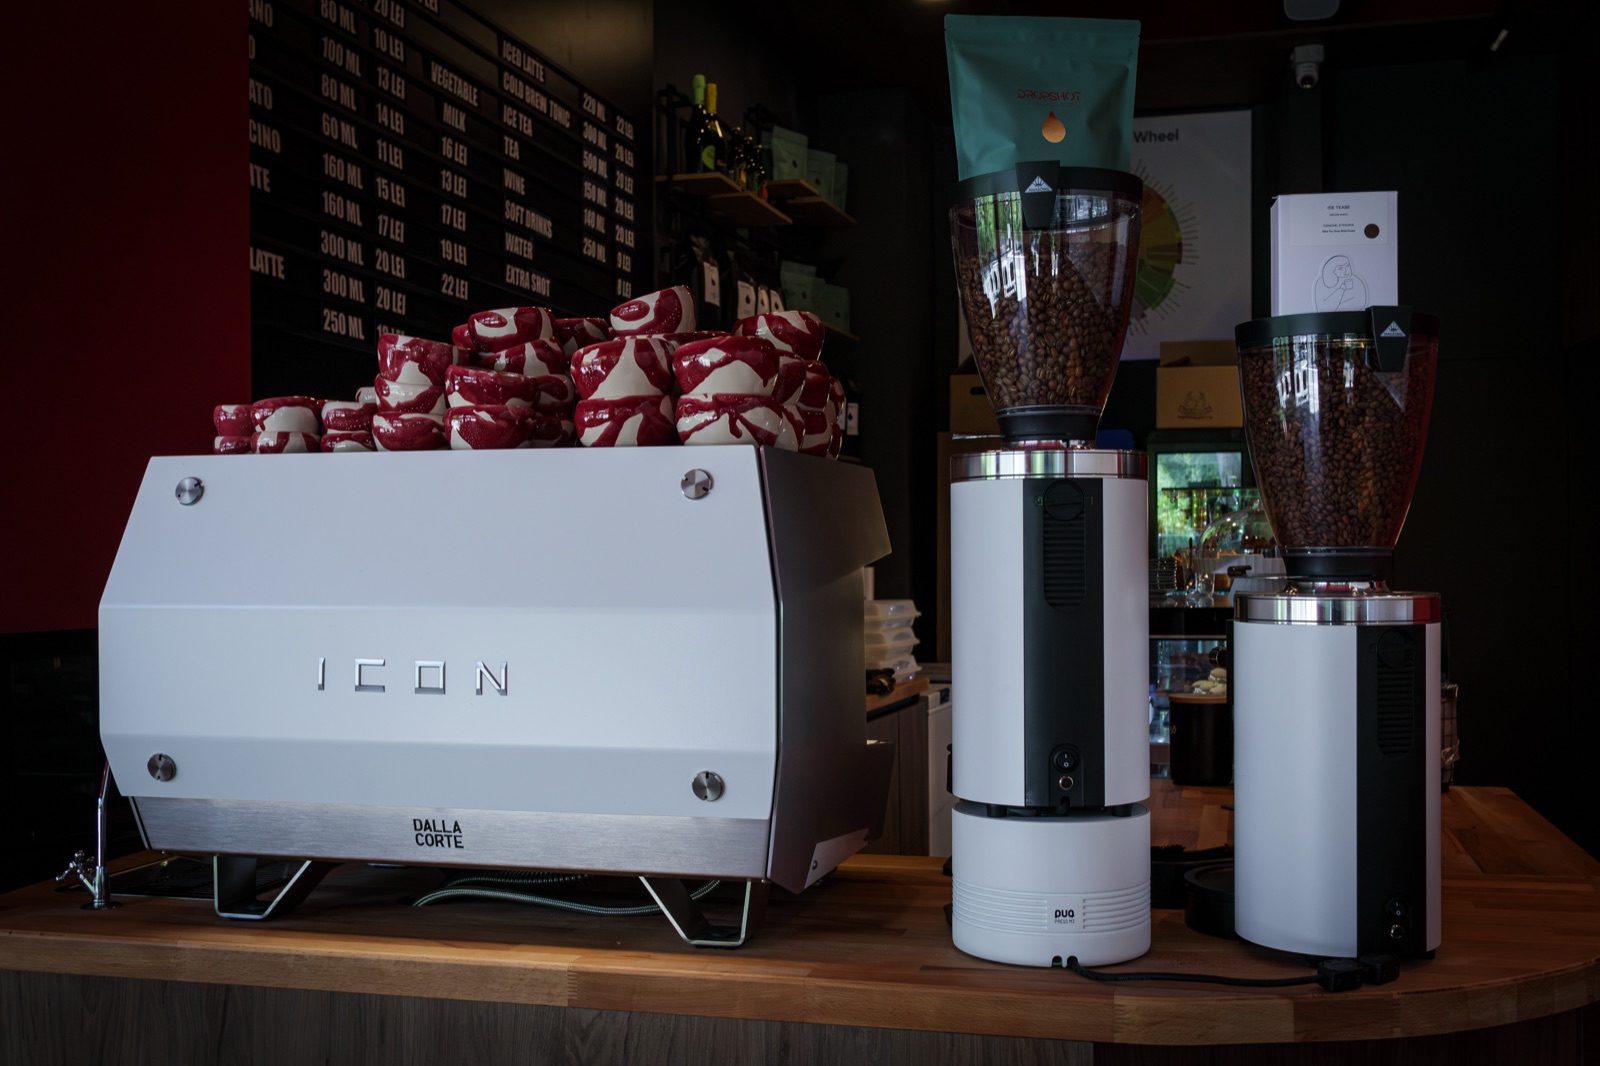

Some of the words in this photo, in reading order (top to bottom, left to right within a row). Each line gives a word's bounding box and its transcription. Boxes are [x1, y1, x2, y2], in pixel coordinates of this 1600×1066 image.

[320, 0, 337, 24] 80
[339, 5, 357, 35] ML
[390, 0, 405, 29] LEI
[321, 35, 344, 68] 100
[345, 47, 362, 78] ML
[373, 27, 387, 53] 10
[388, 34, 405, 63] LEI
[502, 39, 523, 68] ICED
[523, 52, 545, 83] LATTE
[320, 73, 338, 101] 80
[339, 82, 358, 112] ML
[376, 65, 390, 91] 13
[391, 72, 406, 100] LEI
[431, 60, 479, 108] VEGETABLE
[503, 70, 525, 100] COLD
[525, 84, 549, 115] BREW
[549, 100, 571, 129] TONIC
[1017, 88, 1081, 102] DROPSHOT
[321, 112, 339, 141] 60
[340, 120, 359, 150] ML
[376, 101, 389, 128] 14
[389, 107, 405, 136] LEI
[442, 100, 467, 134] MILK
[503, 103, 518, 128] ICE
[518, 111, 534, 138] TEA
[441, 136, 454, 159] 16
[454, 139, 468, 167] LEI
[503, 135, 520, 161] TEA
[1133, 129, 1179, 143] Wheel
[322, 152, 345, 182] 160
[346, 161, 363, 190] ML
[376, 138, 388, 163] 11
[388, 143, 404, 170] LEI
[582, 150, 597, 174] 500
[597, 158, 608, 180] ML
[376, 176, 390, 201] 15
[390, 181, 406, 208] LEI
[440, 169, 453, 193] 13
[453, 176, 468, 199] LEI
[503, 167, 526, 196] WINE
[321, 190, 345, 220] 160
[346, 200, 363, 227] ML
[440, 203, 452, 226] 17
[453, 207, 467, 233] LEI
[504, 200, 525, 226] SOFT
[525, 211, 553, 239] DRINKS
[376, 214, 388, 238] 17
[389, 217, 405, 244] LEI
[504, 231, 534, 261] WATER
[249, 245, 286, 280] LATTE
[320, 229, 345, 260] 300
[347, 239, 365, 267] ML
[375, 248, 390, 274] 20
[390, 254, 405, 279] LEI
[440, 237, 453, 261] 19
[453, 242, 468, 267] LEI
[322, 268, 347, 299] 300
[349, 277, 366, 304] ML
[441, 273, 454, 297] 22
[454, 276, 469, 301] LEI
[505, 263, 530, 291] EXTRA
[531, 271, 551, 298] SHOT
[376, 286, 390, 311] 20
[391, 292, 407, 316] LEI
[323, 307, 346, 336] 250
[348, 314, 366, 341] ML
[318, 657, 508, 696] ICON
[413, 818, 462, 834] DALLA
[415, 832, 464, 849] CORTE
